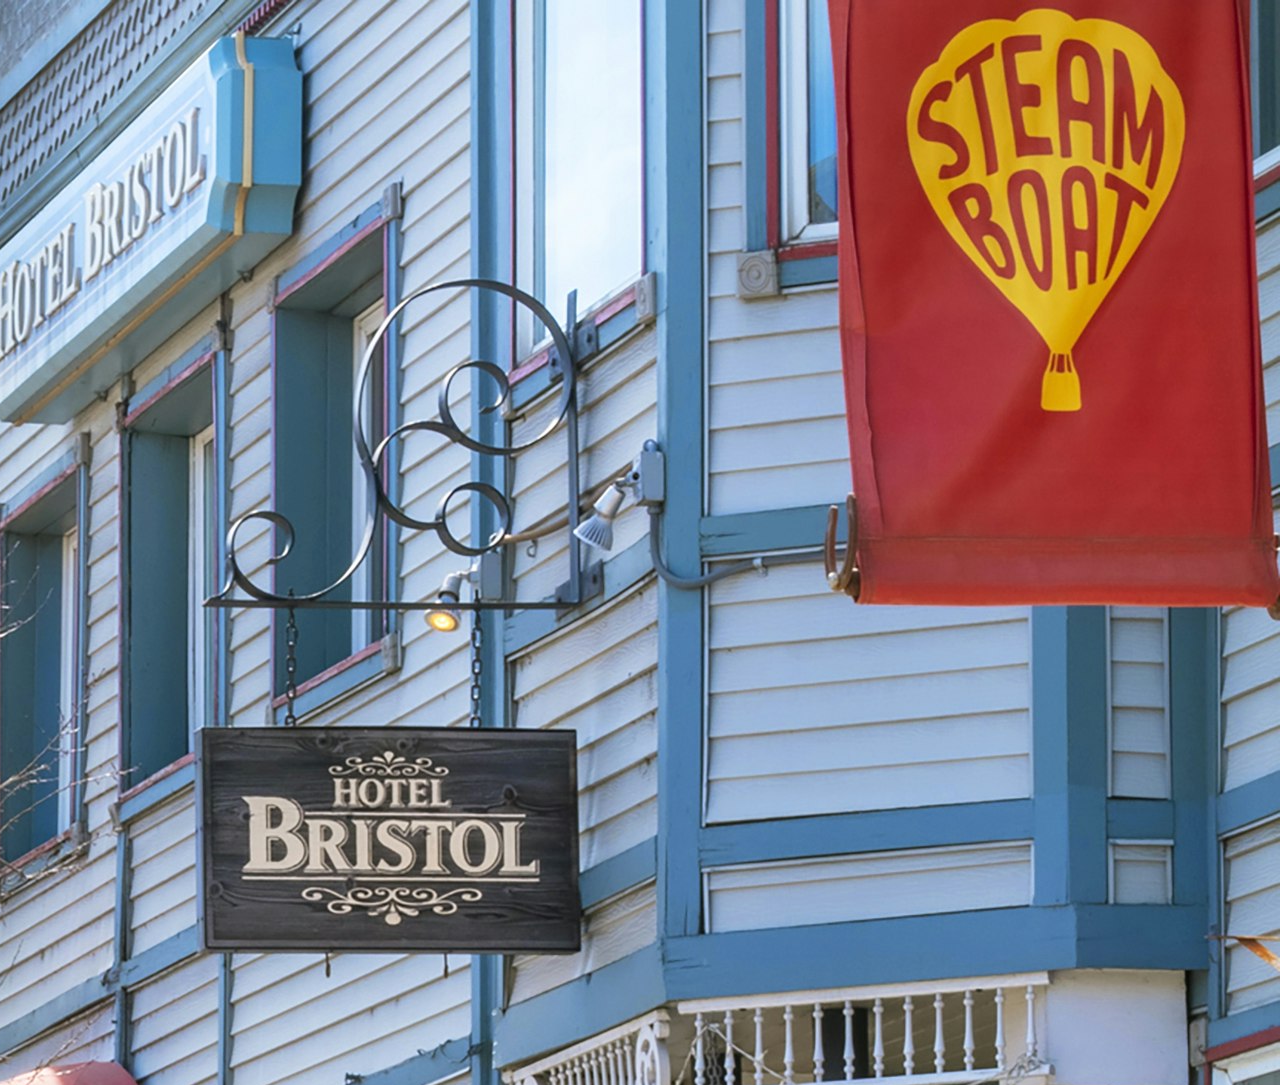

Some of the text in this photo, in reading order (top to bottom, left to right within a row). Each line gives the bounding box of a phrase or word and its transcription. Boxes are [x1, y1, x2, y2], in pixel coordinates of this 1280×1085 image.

[917, 35, 1164, 190] STEAM
[84, 106, 206, 283] BRISTOL
[948, 165, 1149, 292] BOAT
[242, 796, 540, 875] BRISTOL
[333, 778, 452, 808] HOTEL
